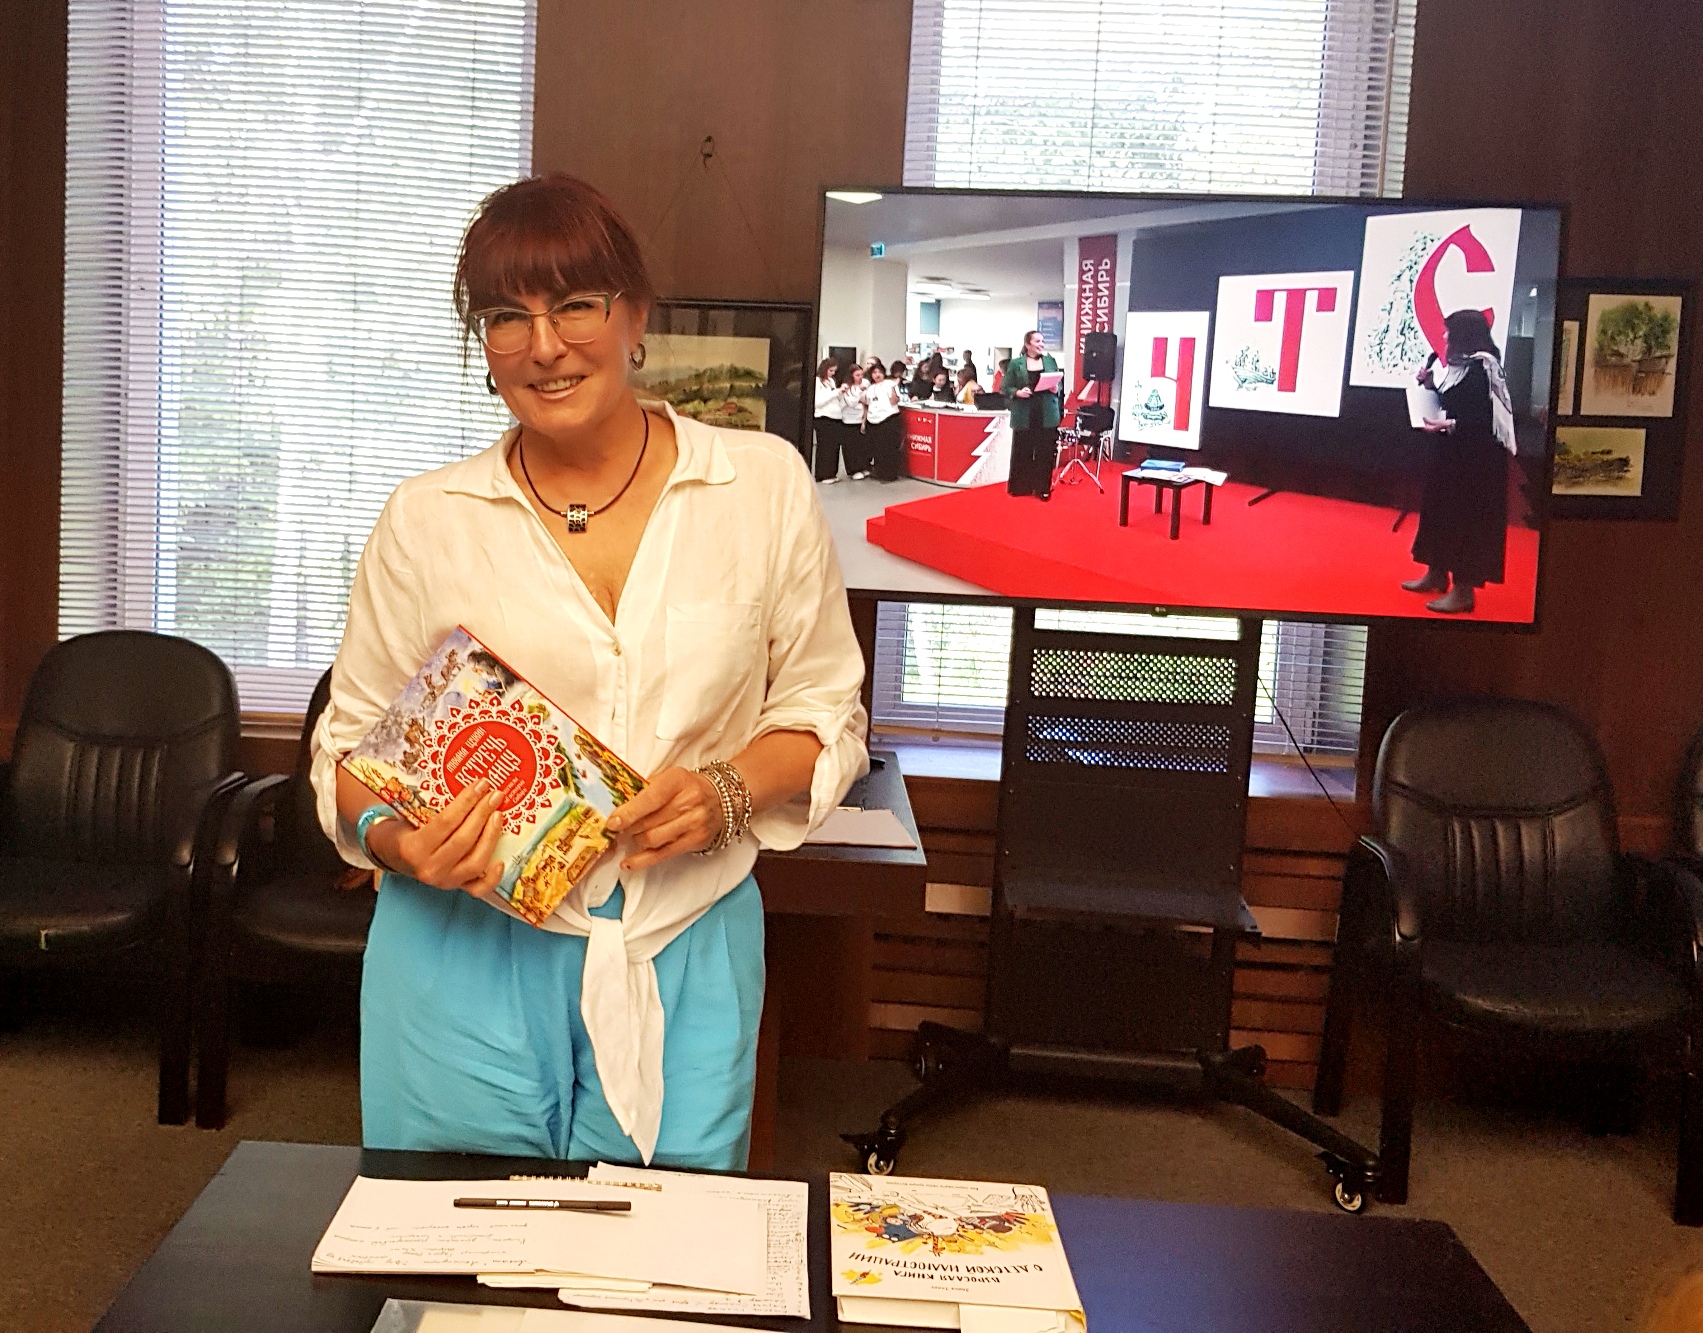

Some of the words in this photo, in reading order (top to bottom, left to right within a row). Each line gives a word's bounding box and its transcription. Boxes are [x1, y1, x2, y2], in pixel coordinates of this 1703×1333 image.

[1095, 258, 1111, 333] СИБИРЬ
[1253, 287, 1338, 393] Т
[1150, 337, 1197, 432] Ч
[454, 735, 508, 787] ВСТРЕЧЬ
[487, 748, 522, 791] ОЛНЦУ
[848, 1252, 960, 1272] ИЛЛЮСТРАЦИИ
[893, 1269, 938, 1281] КНИГА
[940, 1275, 1001, 1284] ВЗРОСЛАЯ
[966, 1264, 1030, 1274] ДЕТСКОЙ
